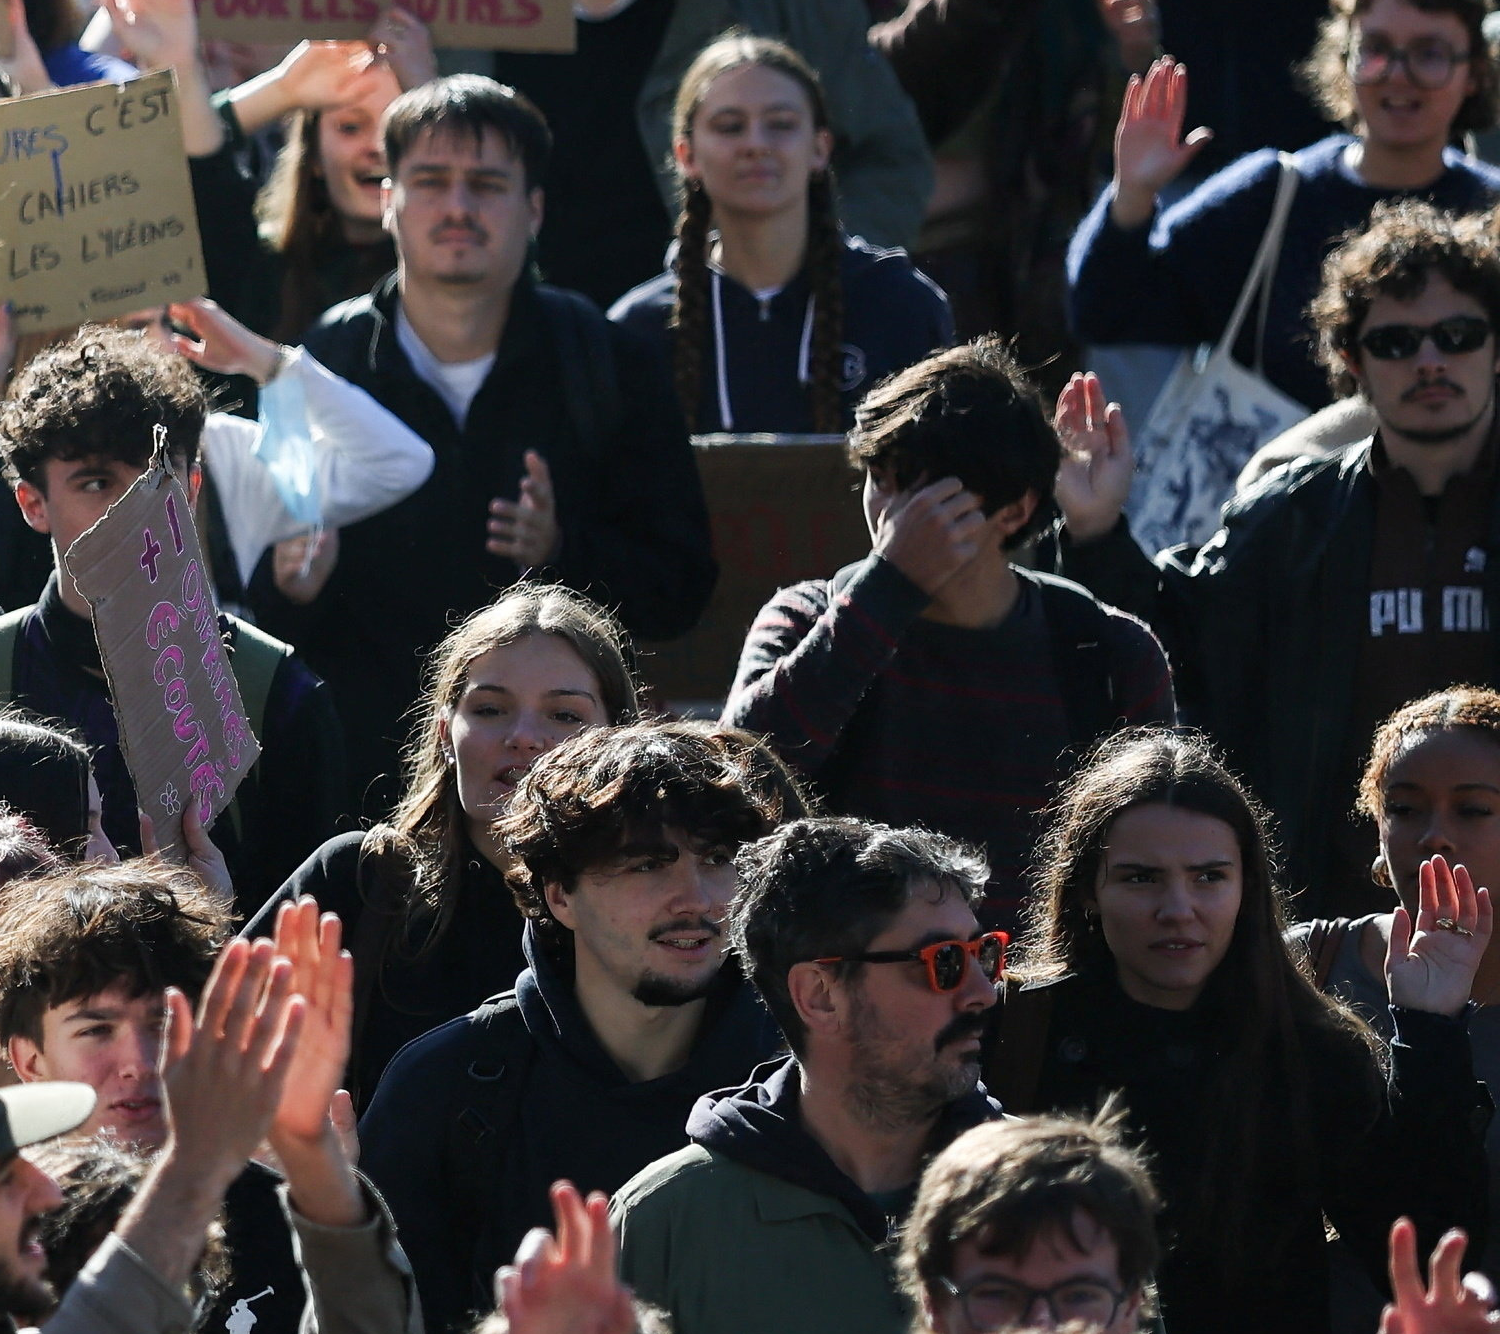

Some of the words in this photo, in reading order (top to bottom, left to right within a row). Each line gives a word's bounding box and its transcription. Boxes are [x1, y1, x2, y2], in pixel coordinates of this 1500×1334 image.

[85, 85, 171, 138] C'EST
[18, 170, 141, 226] CAHIERS
[8, 239, 61, 281] LES
[181, 558, 249, 771] OPPRIMÉS
[145, 601, 226, 825] ÉCOUTÉS
